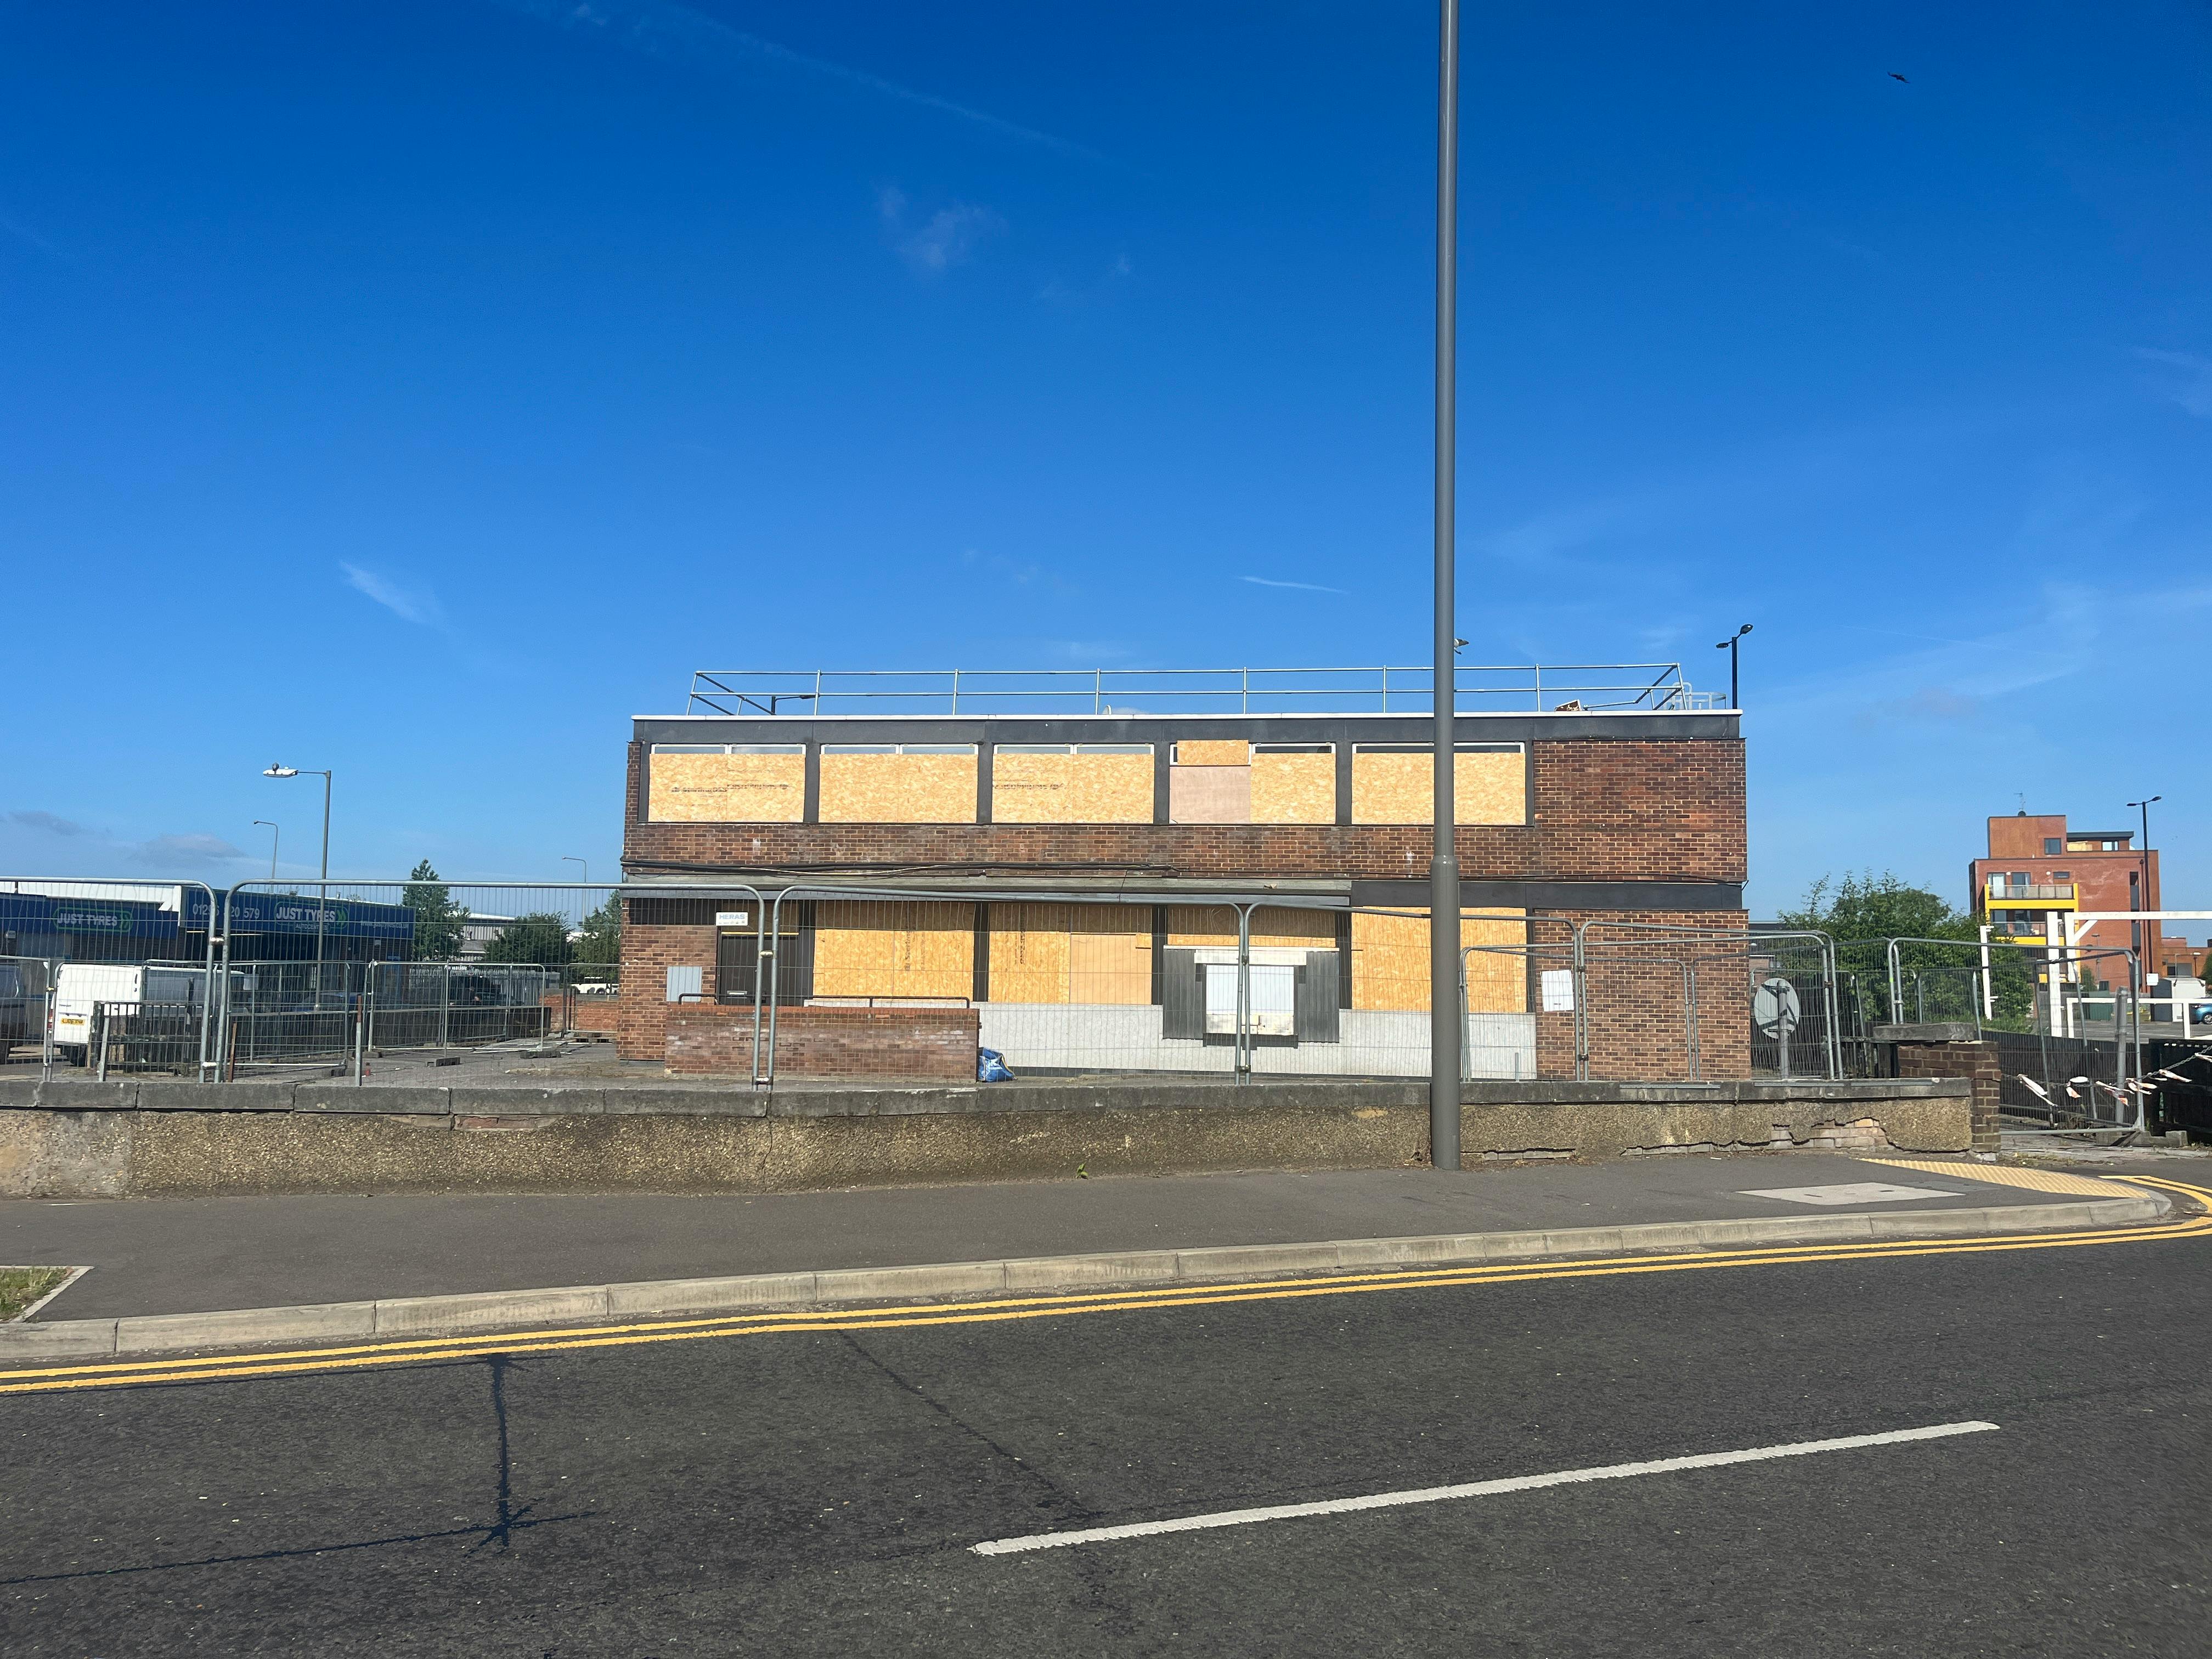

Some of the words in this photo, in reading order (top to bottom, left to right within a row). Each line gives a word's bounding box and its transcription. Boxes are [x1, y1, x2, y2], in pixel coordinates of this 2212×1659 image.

[193, 903, 219, 916] 0126
[244, 907, 260, 919] 579
[276, 906, 302, 921] JUST
[304, 909, 336, 923] TYRES
[58, 912, 83, 924] JUST
[86, 914, 117, 927] TYRES
